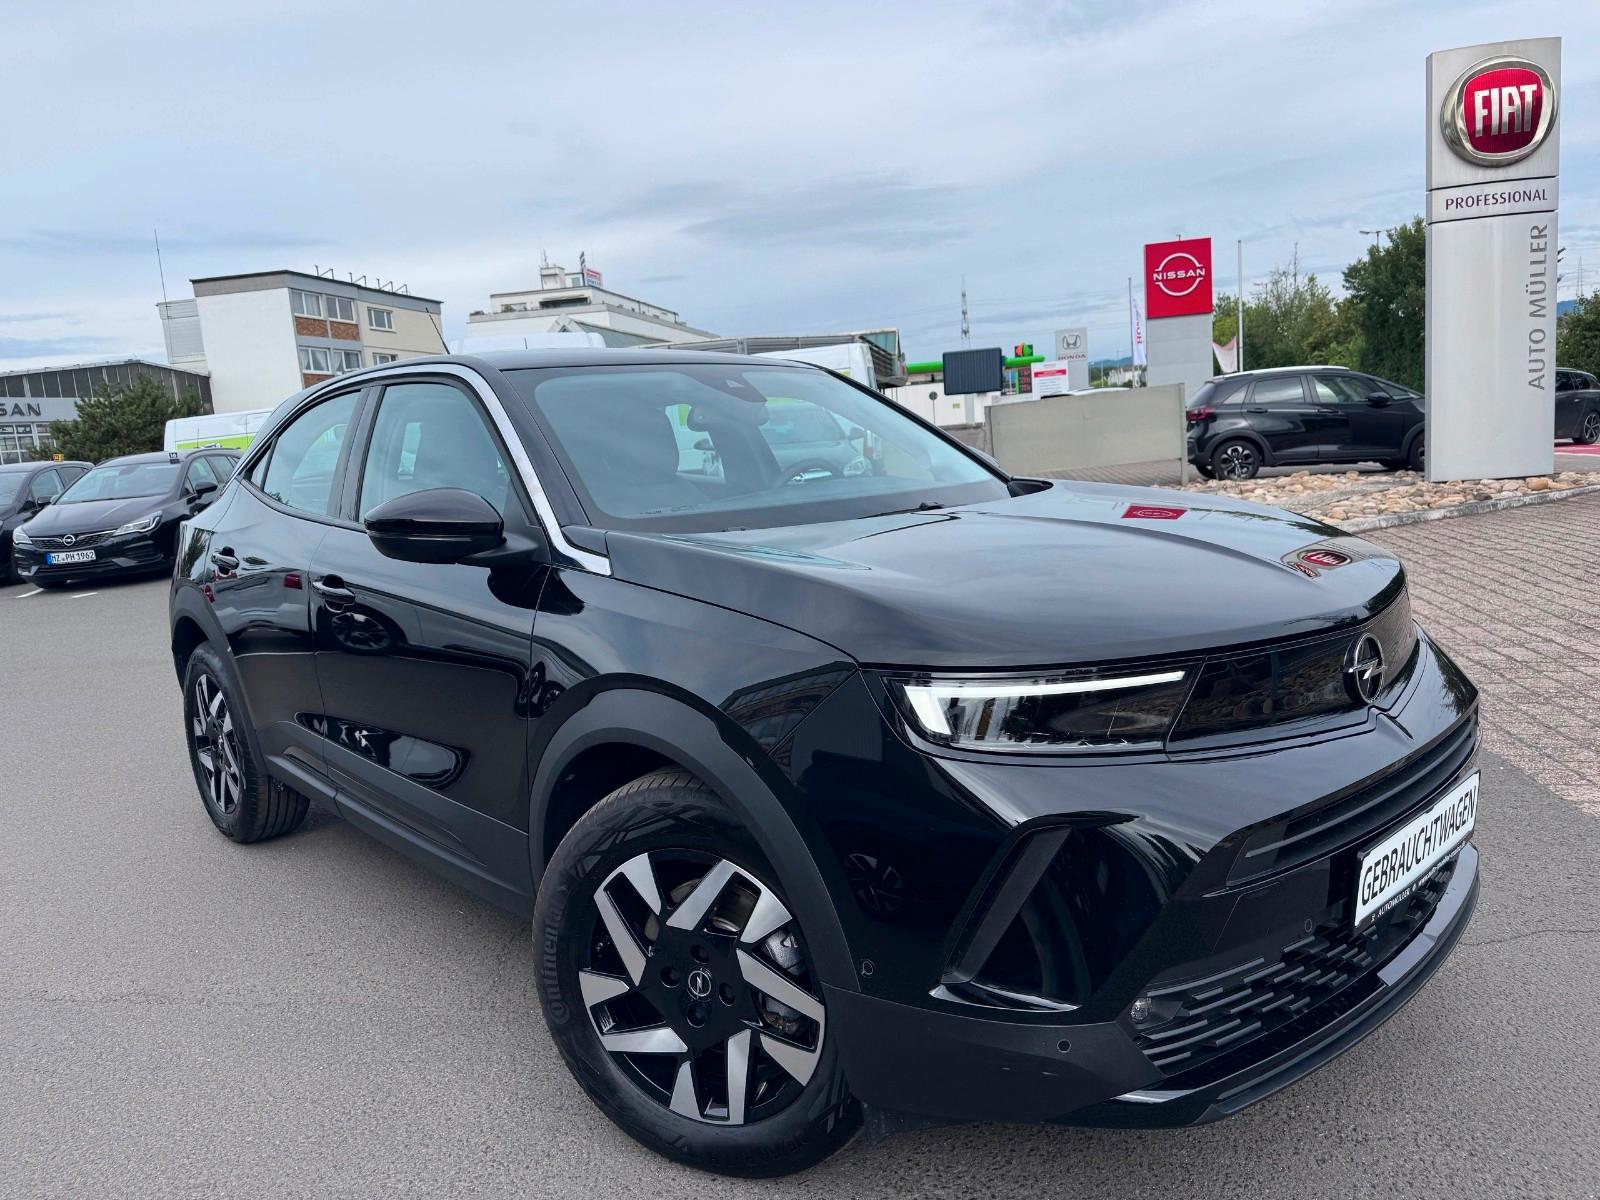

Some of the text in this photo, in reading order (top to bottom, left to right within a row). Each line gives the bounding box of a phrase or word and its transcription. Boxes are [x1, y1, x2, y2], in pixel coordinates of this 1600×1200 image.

[1474, 84, 1537, 137] FIAT
[1445, 189, 1548, 211] PROFESSIONAL
[1153, 268, 1205, 281] NISSAN
[1525, 224, 1548, 391] AUTO MÜLLER
[1057, 353, 1087, 361] HONDA
[1361, 785, 1477, 906] GEBRAUCHTWAGEN
